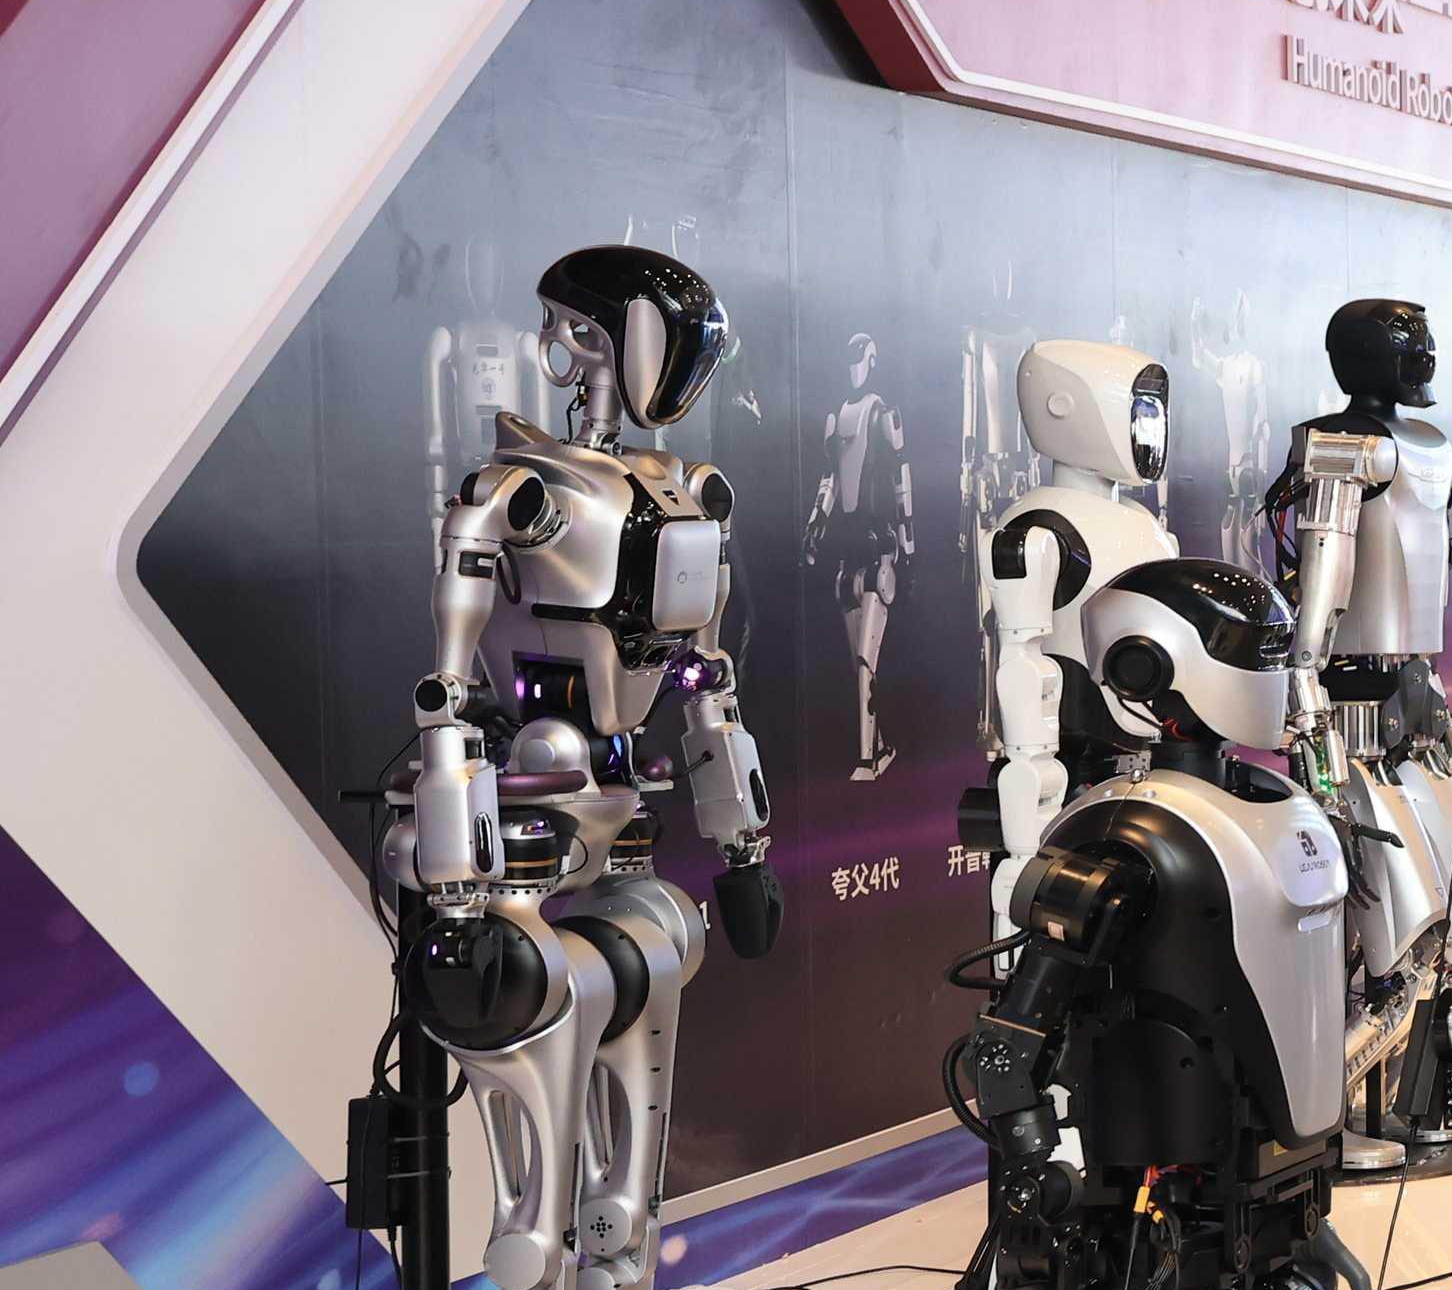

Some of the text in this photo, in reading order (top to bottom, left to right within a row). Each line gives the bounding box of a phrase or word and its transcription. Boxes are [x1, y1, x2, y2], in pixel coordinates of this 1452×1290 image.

[1285, 34, 1401, 111] Humanoid
[831, 856, 900, 901] 夸父4代
[948, 844, 991, 877] 开普
